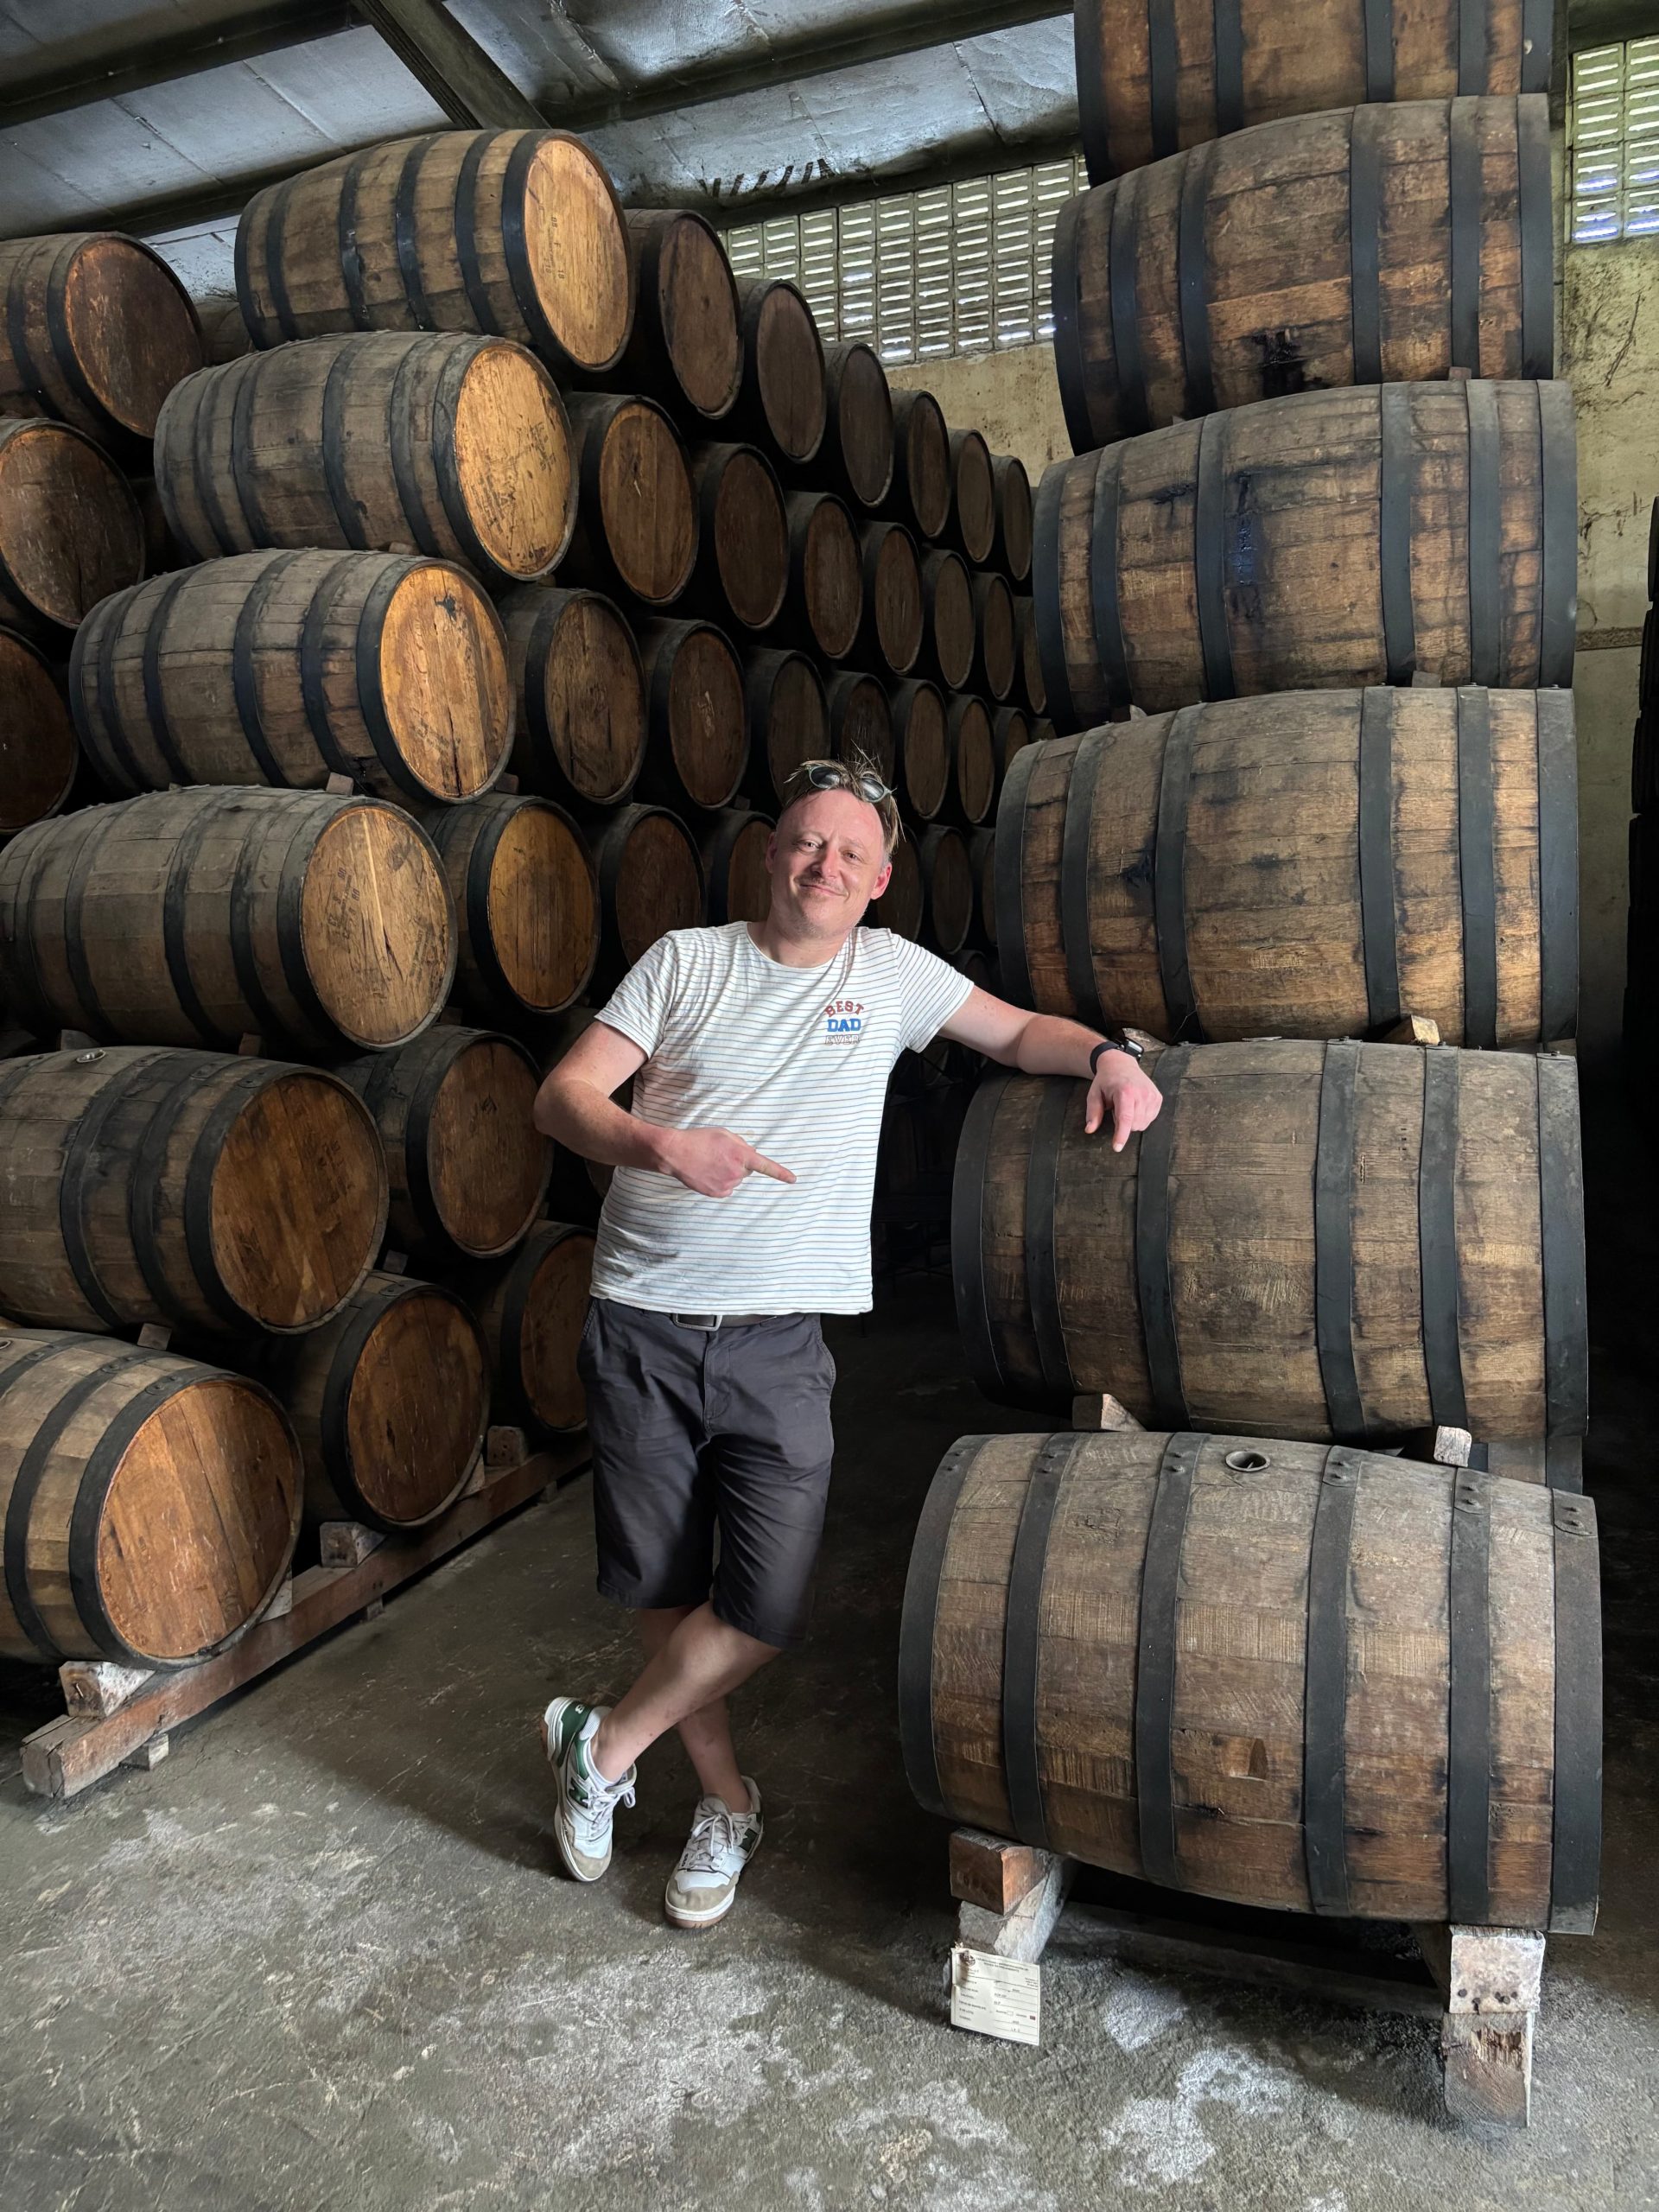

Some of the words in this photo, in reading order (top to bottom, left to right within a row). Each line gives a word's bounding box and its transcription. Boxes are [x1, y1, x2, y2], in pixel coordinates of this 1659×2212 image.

[824, 1000, 864, 1018] BEST
[827, 1018, 861, 1033] DAD
[824, 1034, 861, 1046] EVER
